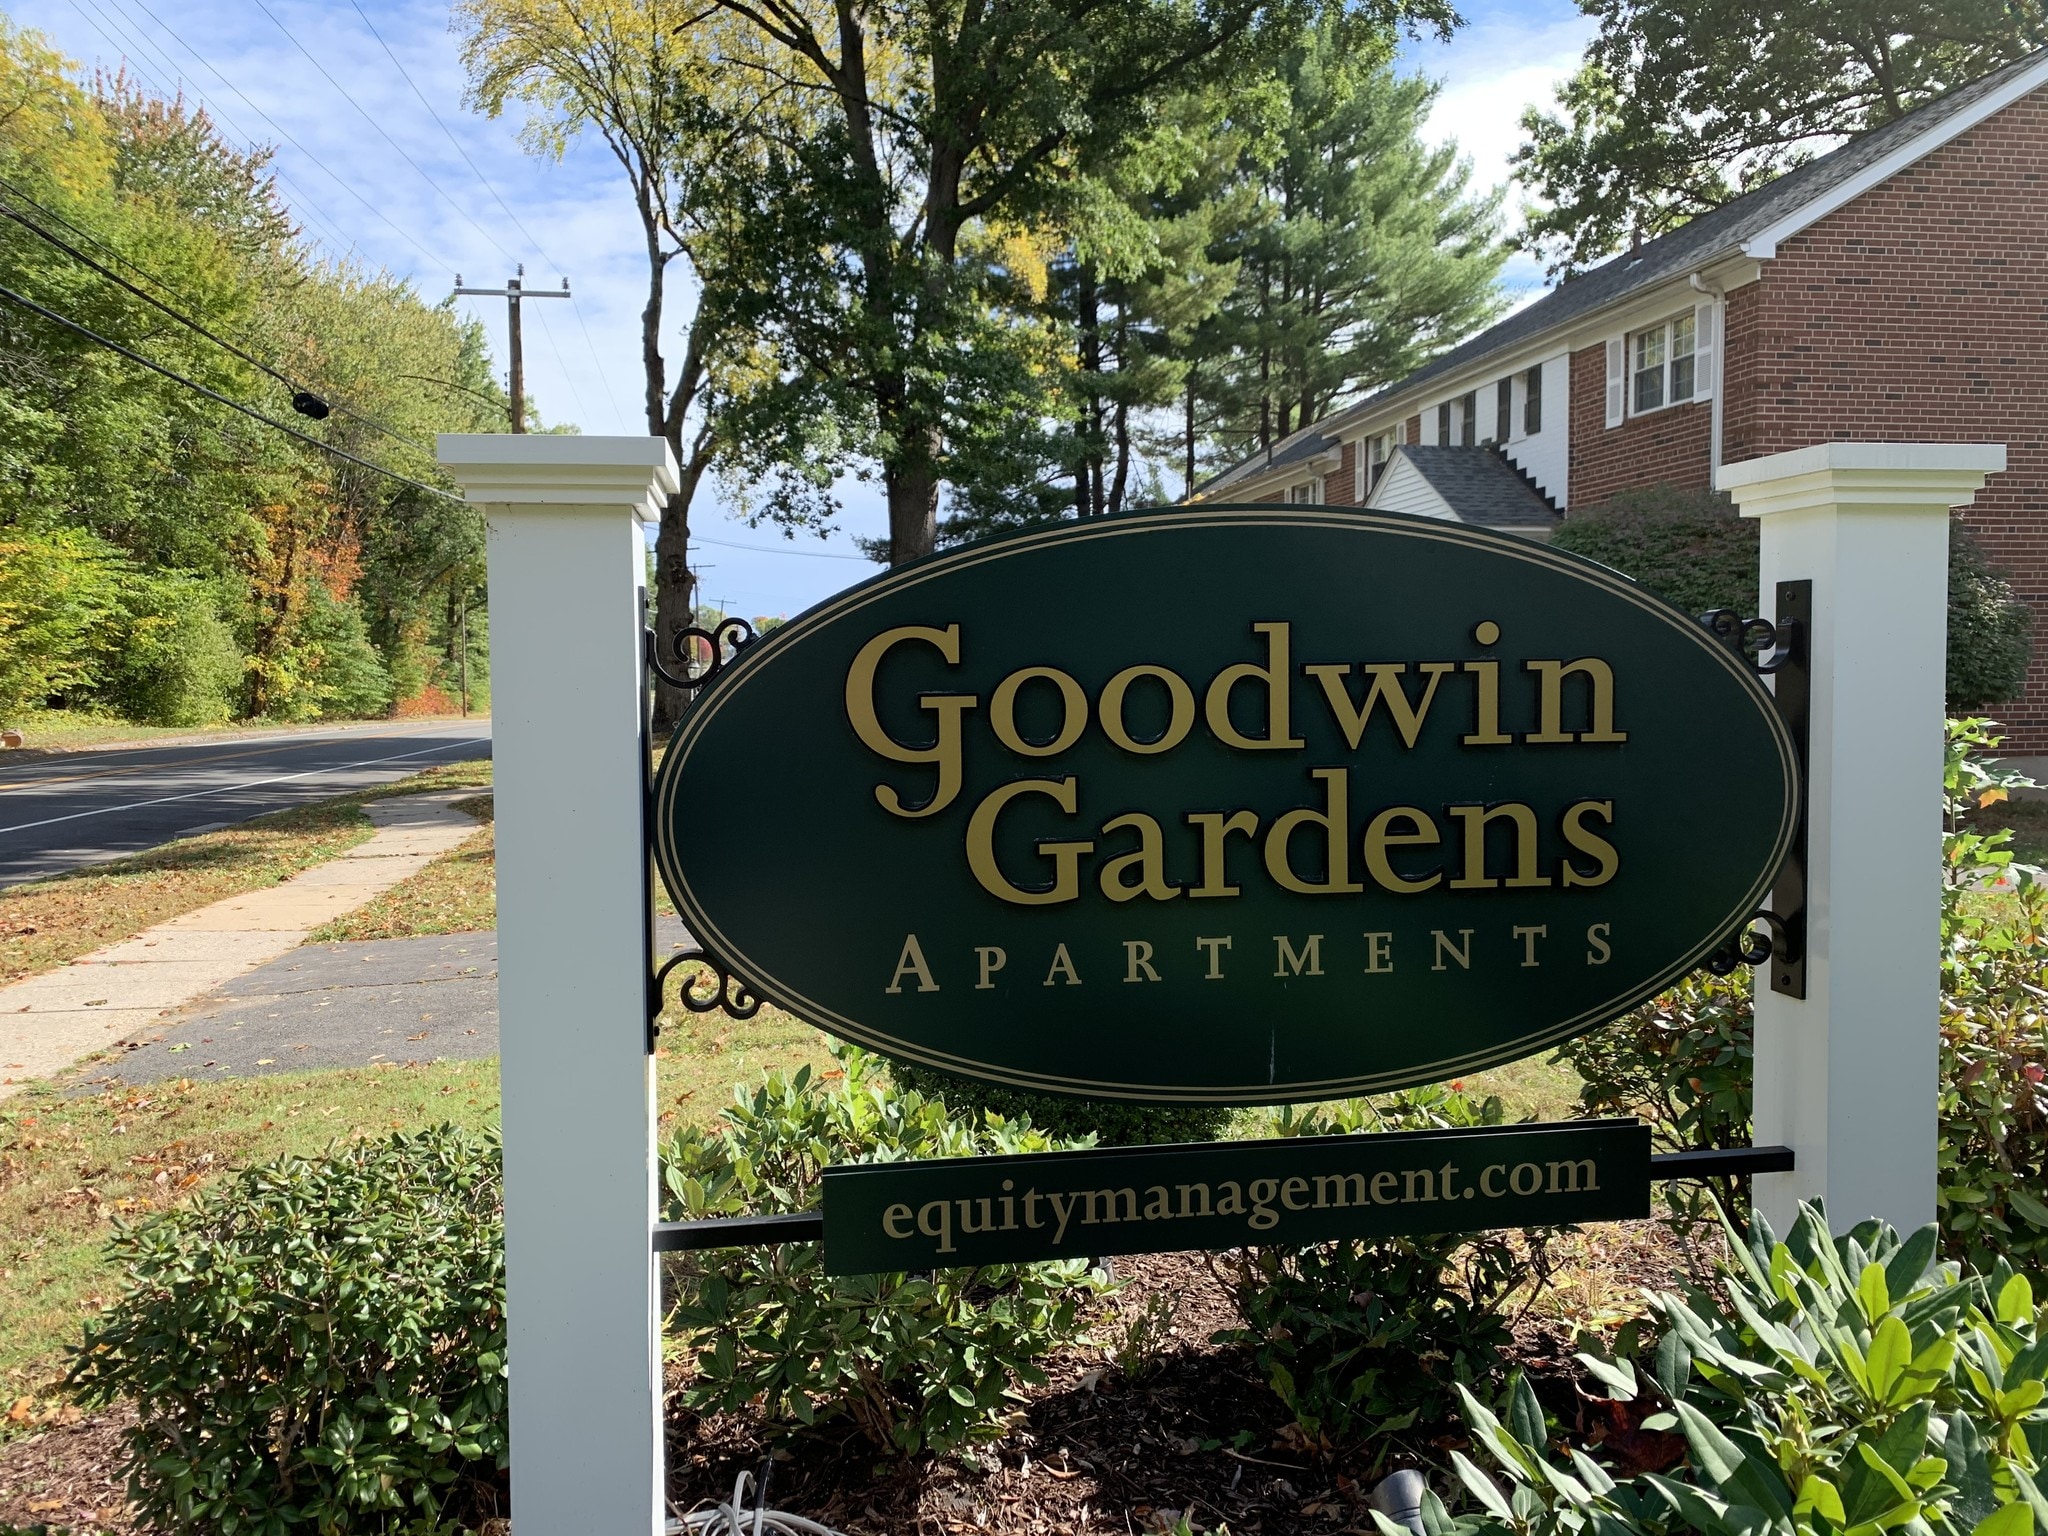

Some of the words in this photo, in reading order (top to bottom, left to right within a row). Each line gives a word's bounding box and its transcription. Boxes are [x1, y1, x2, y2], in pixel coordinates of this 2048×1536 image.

[845, 621, 1627, 818] Goodwin
[966, 768, 1620, 905] Gardens
[885, 922, 1612, 994] APARTMENTS
[882, 1154, 1600, 1254] equitymanagement.com
